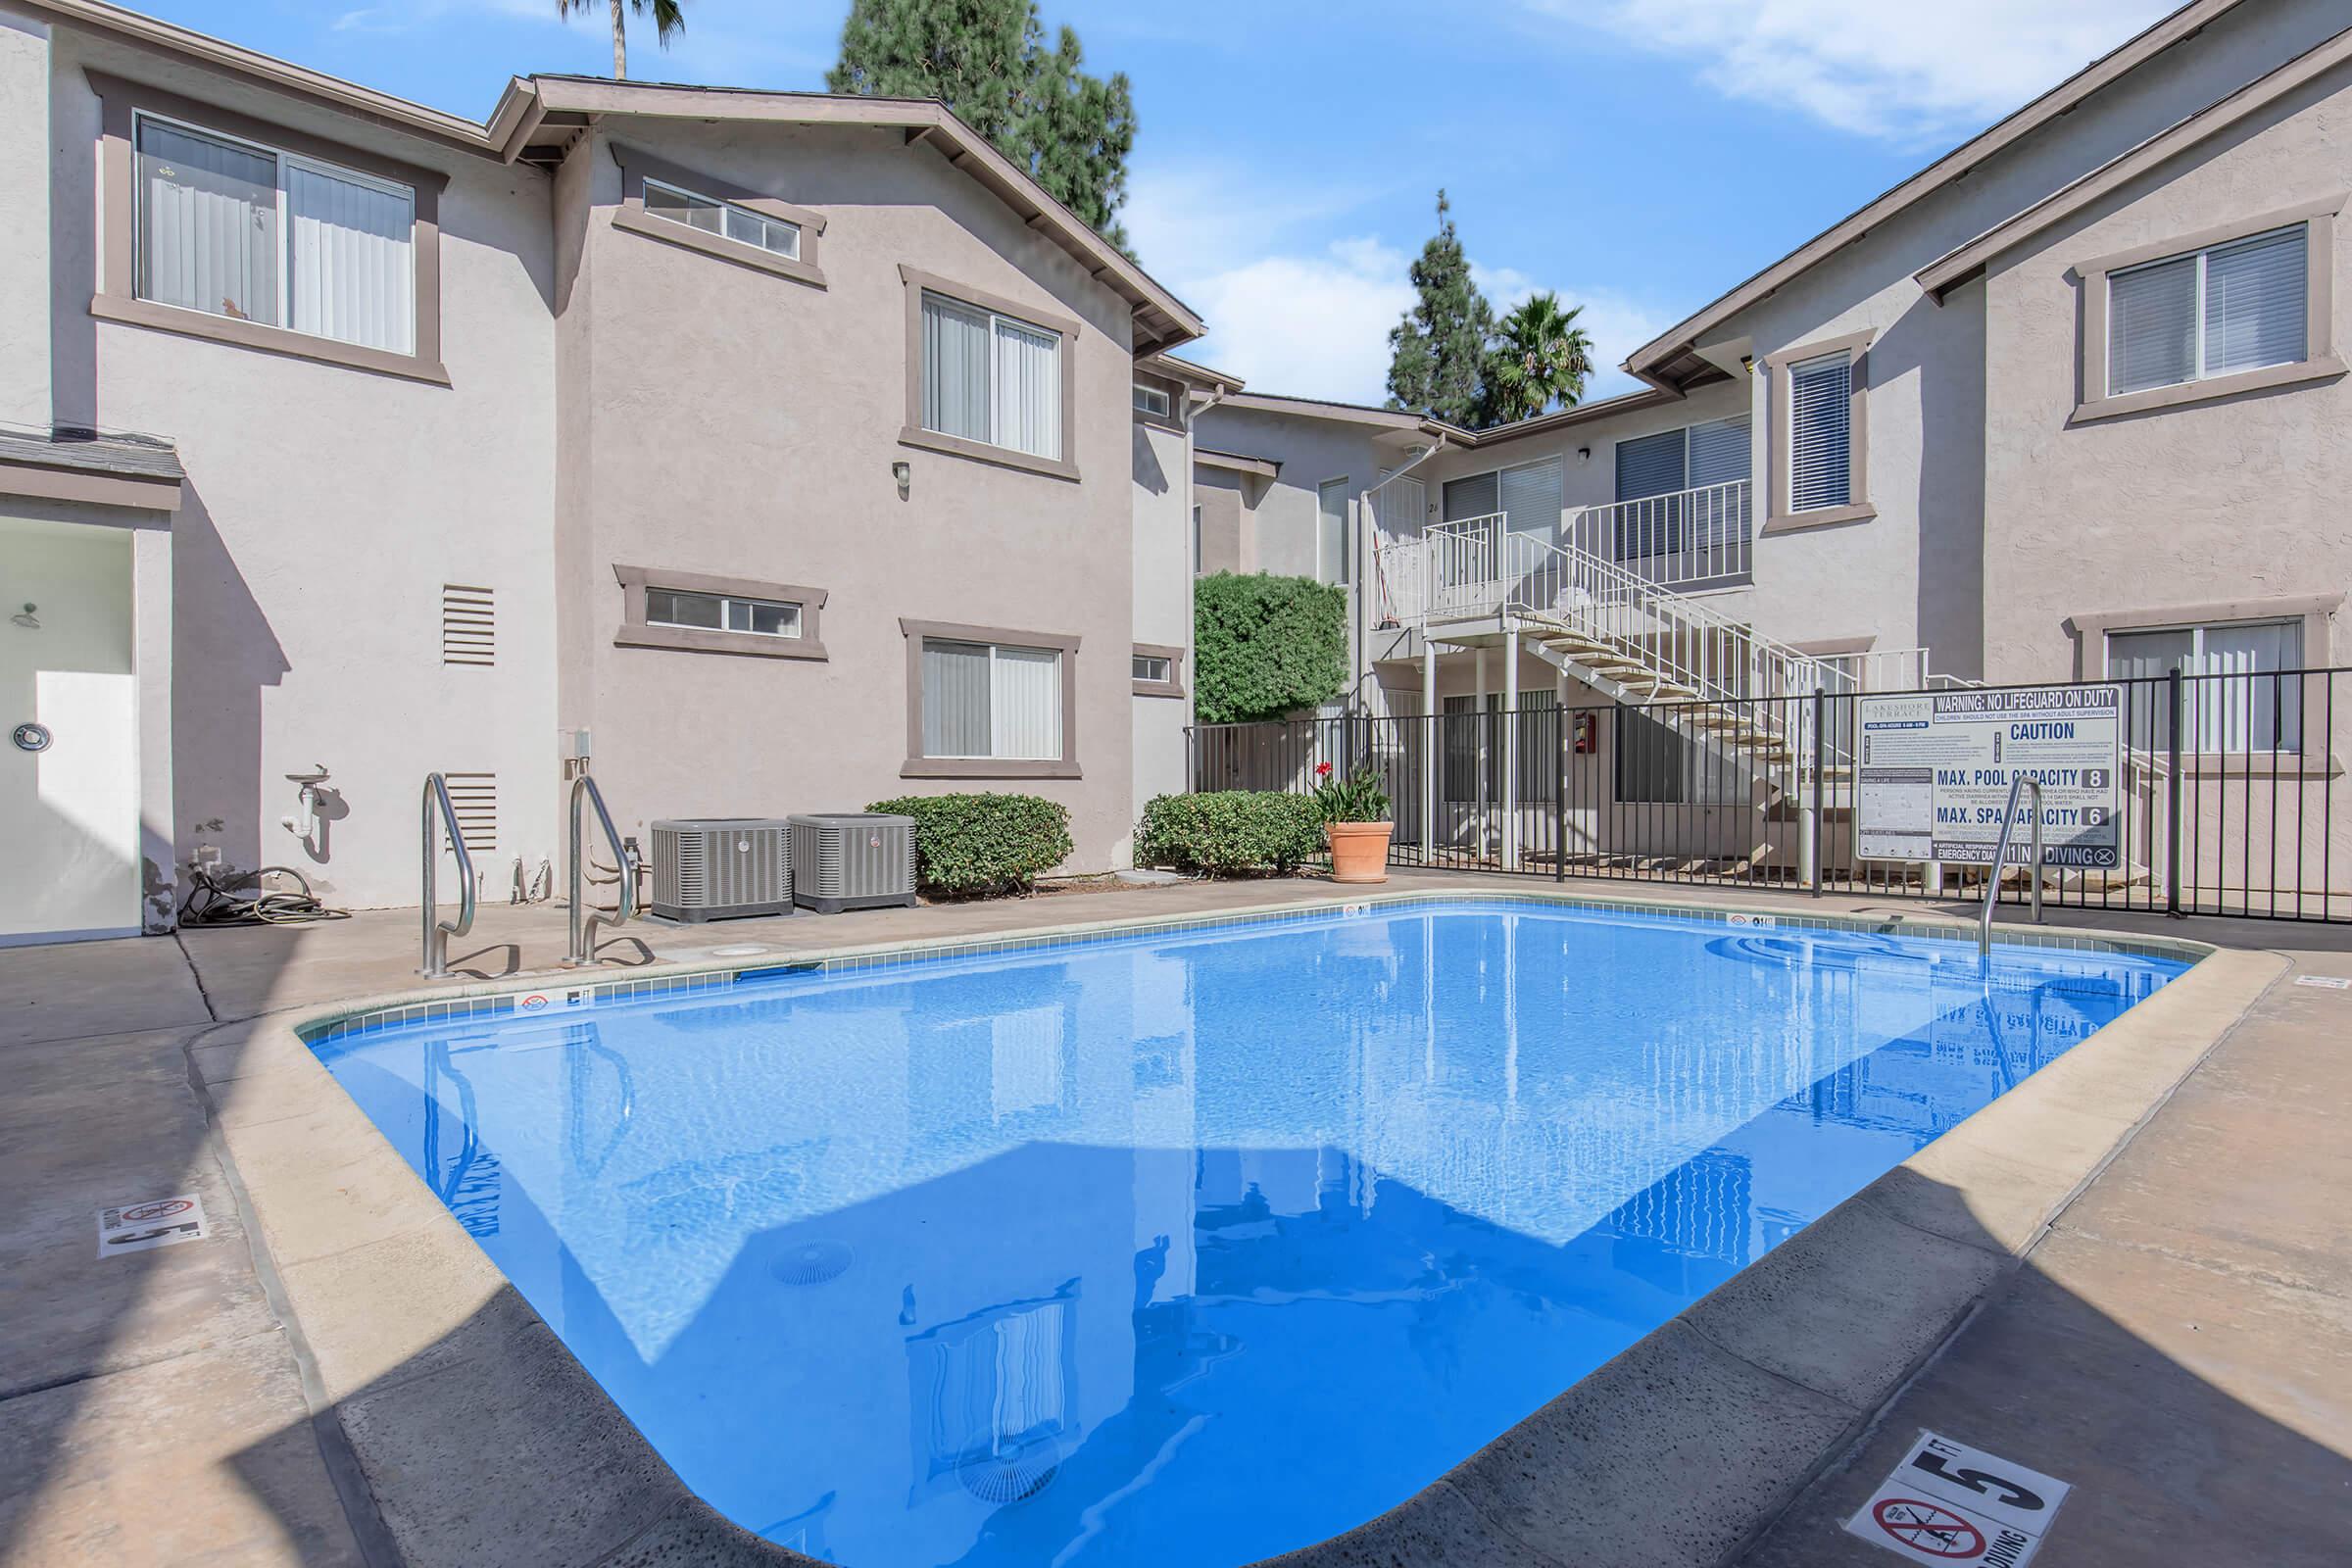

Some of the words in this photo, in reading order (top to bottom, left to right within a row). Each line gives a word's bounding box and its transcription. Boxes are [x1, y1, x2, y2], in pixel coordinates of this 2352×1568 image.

[1936, 695, 1985, 712] WARNING:
[1987, 693, 2002, 710] NO
[2005, 691, 2063, 710] LIFEGUARD
[2066, 690, 2082, 708] ON
[2084, 689, 2114, 707] DUTY
[2011, 722, 2075, 740] CAUTION
[1937, 769, 1971, 785] MAX.
[1975, 769, 2008, 785] POOL
[2089, 770, 2101, 787] 8
[1937, 808, 1972, 823] MAX.
[1977, 808, 2003, 824] SPA
[2089, 808, 2101, 825] 6
[1937, 849, 1981, 860] EMERGENCY
[2045, 847, 2093, 863] DIVING
[107, 1221, 199, 1245] 5
[1928, 1439, 1962, 1458] FT
[1911, 1450, 2045, 1510] 5
[1983, 1530, 2028, 1568] DIVING
